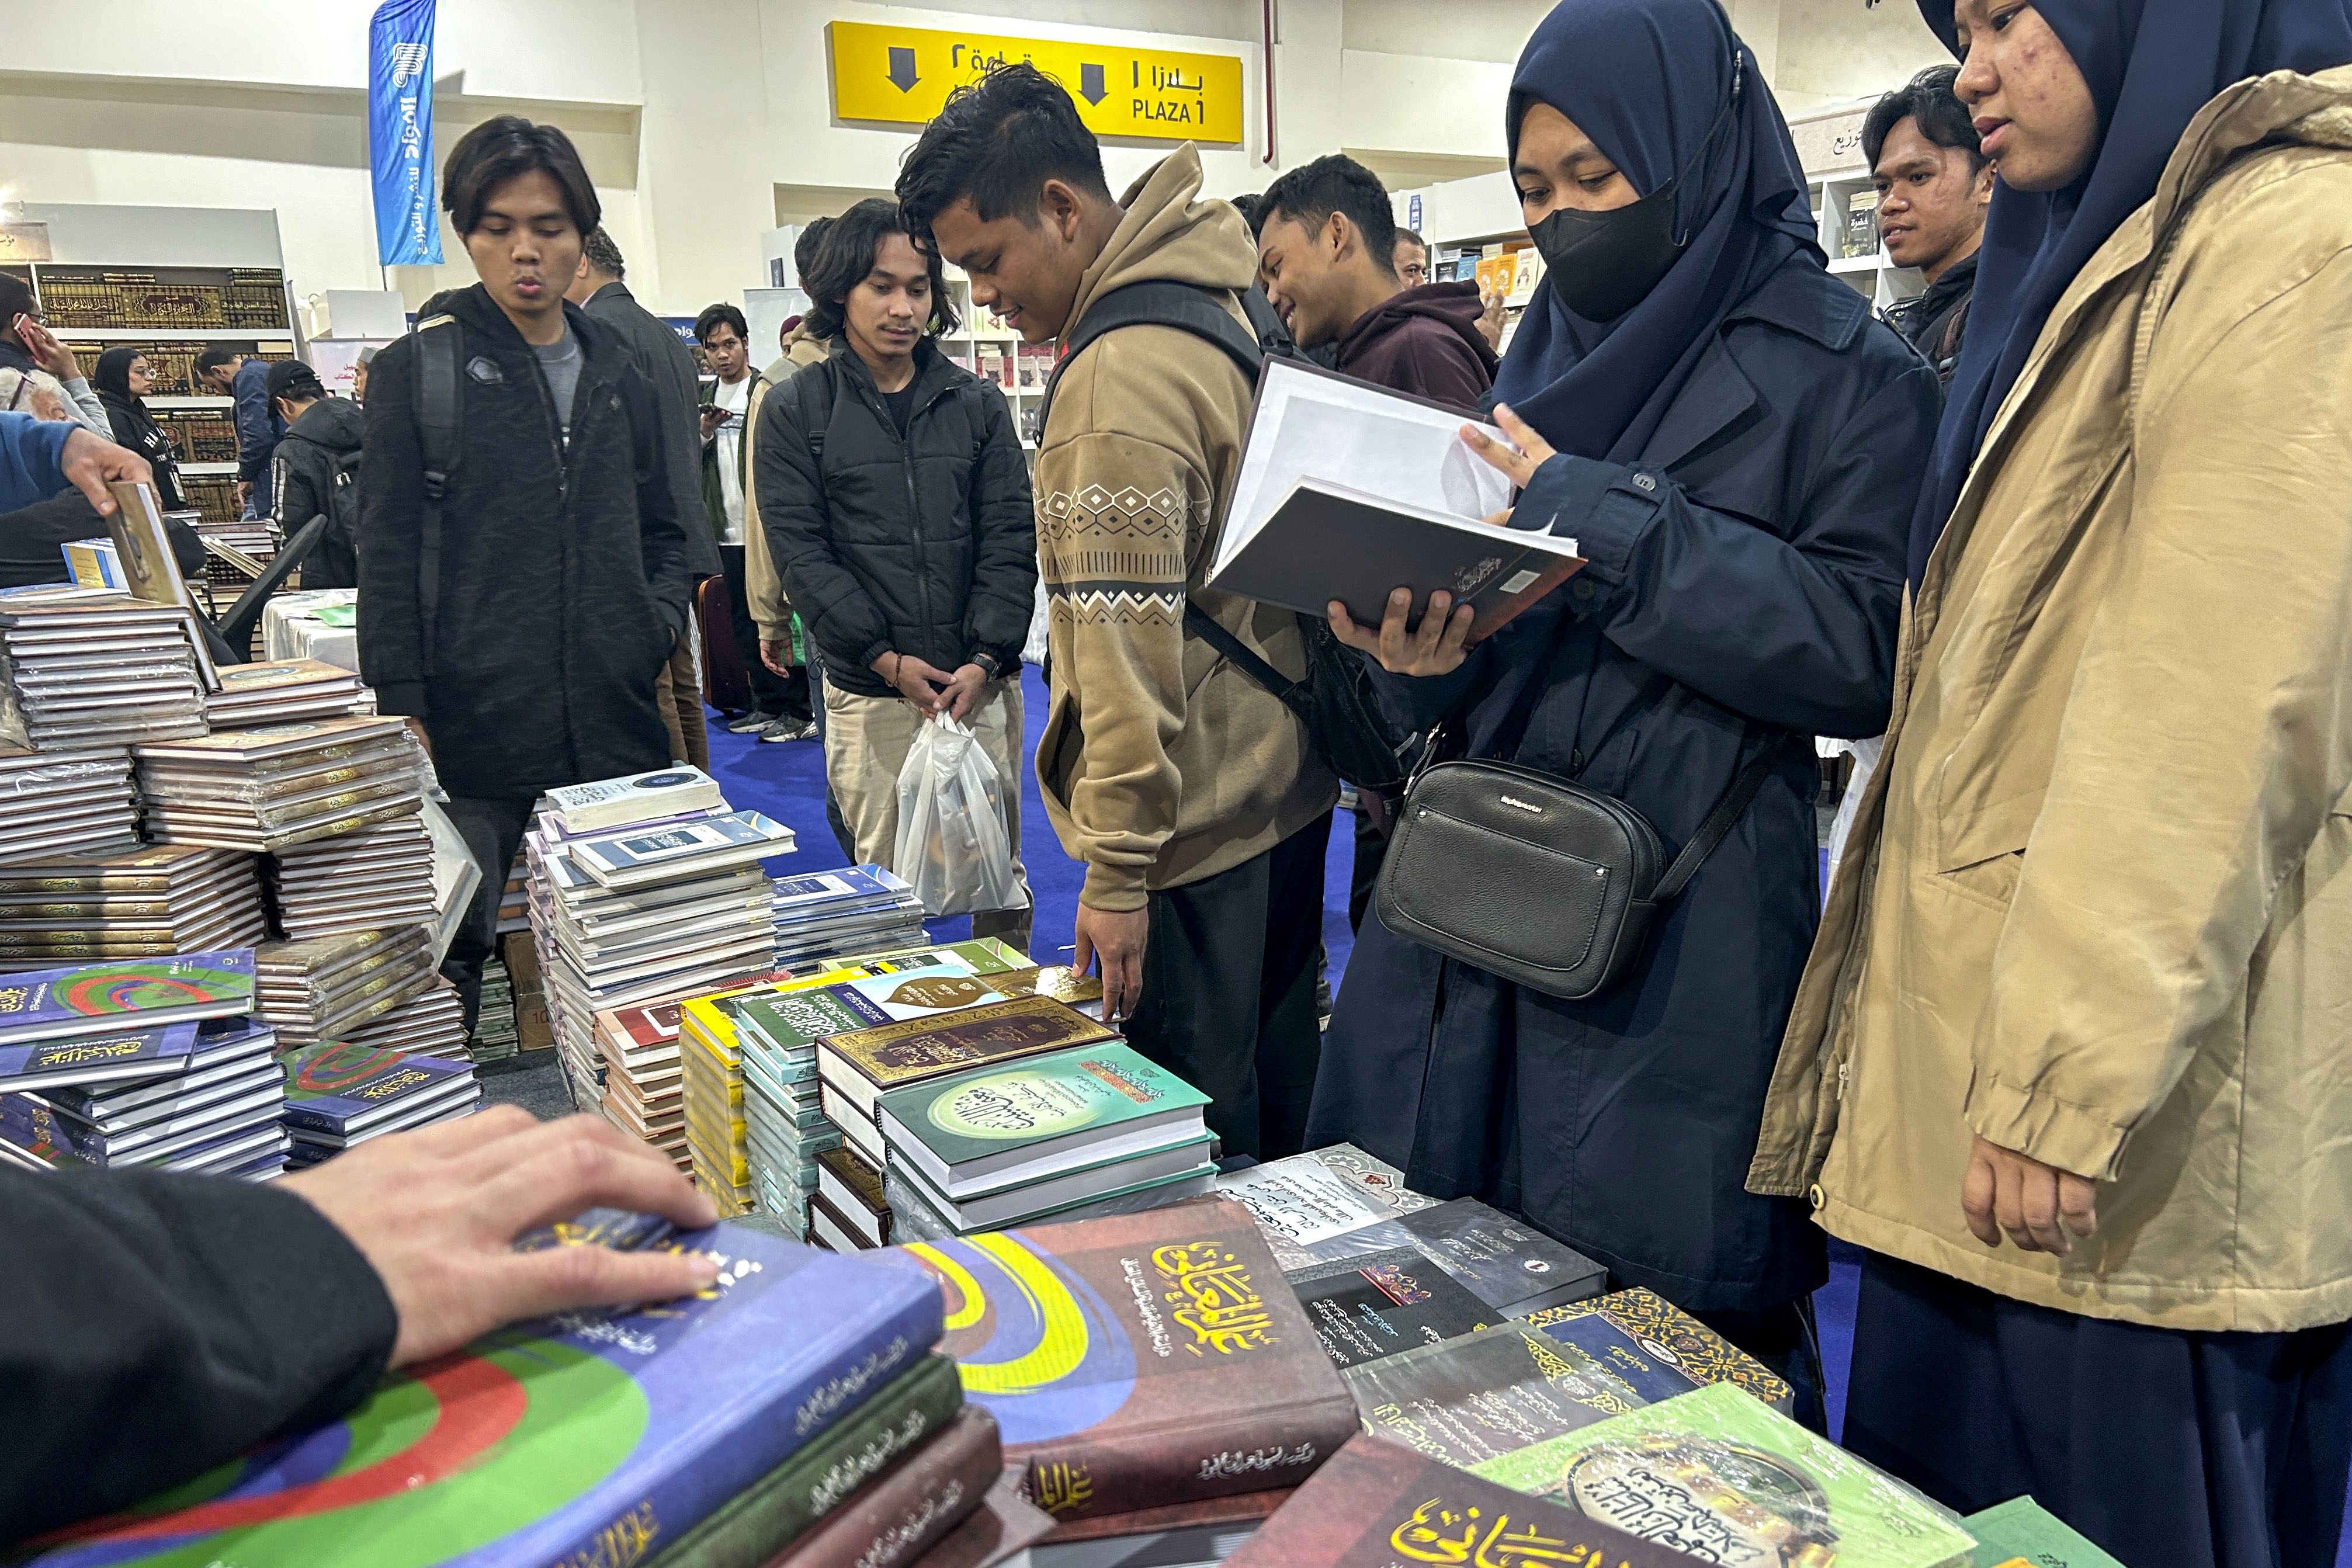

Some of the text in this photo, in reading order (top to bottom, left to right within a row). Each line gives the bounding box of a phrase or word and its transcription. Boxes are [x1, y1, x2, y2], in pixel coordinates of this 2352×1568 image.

[1152, 65, 1203, 96] بلازا
[1133, 99, 1205, 125] PLAZA 1
[408, 167, 424, 200] للنشر
[411, 211, 428, 255] التوزيع
[1244, 1182, 1320, 1229] على متن الرسالة
[1295, 1184, 1317, 1197] مذهب
[1335, 1209, 1353, 1220] مالك
[1170, 1306, 1281, 1358] علم
